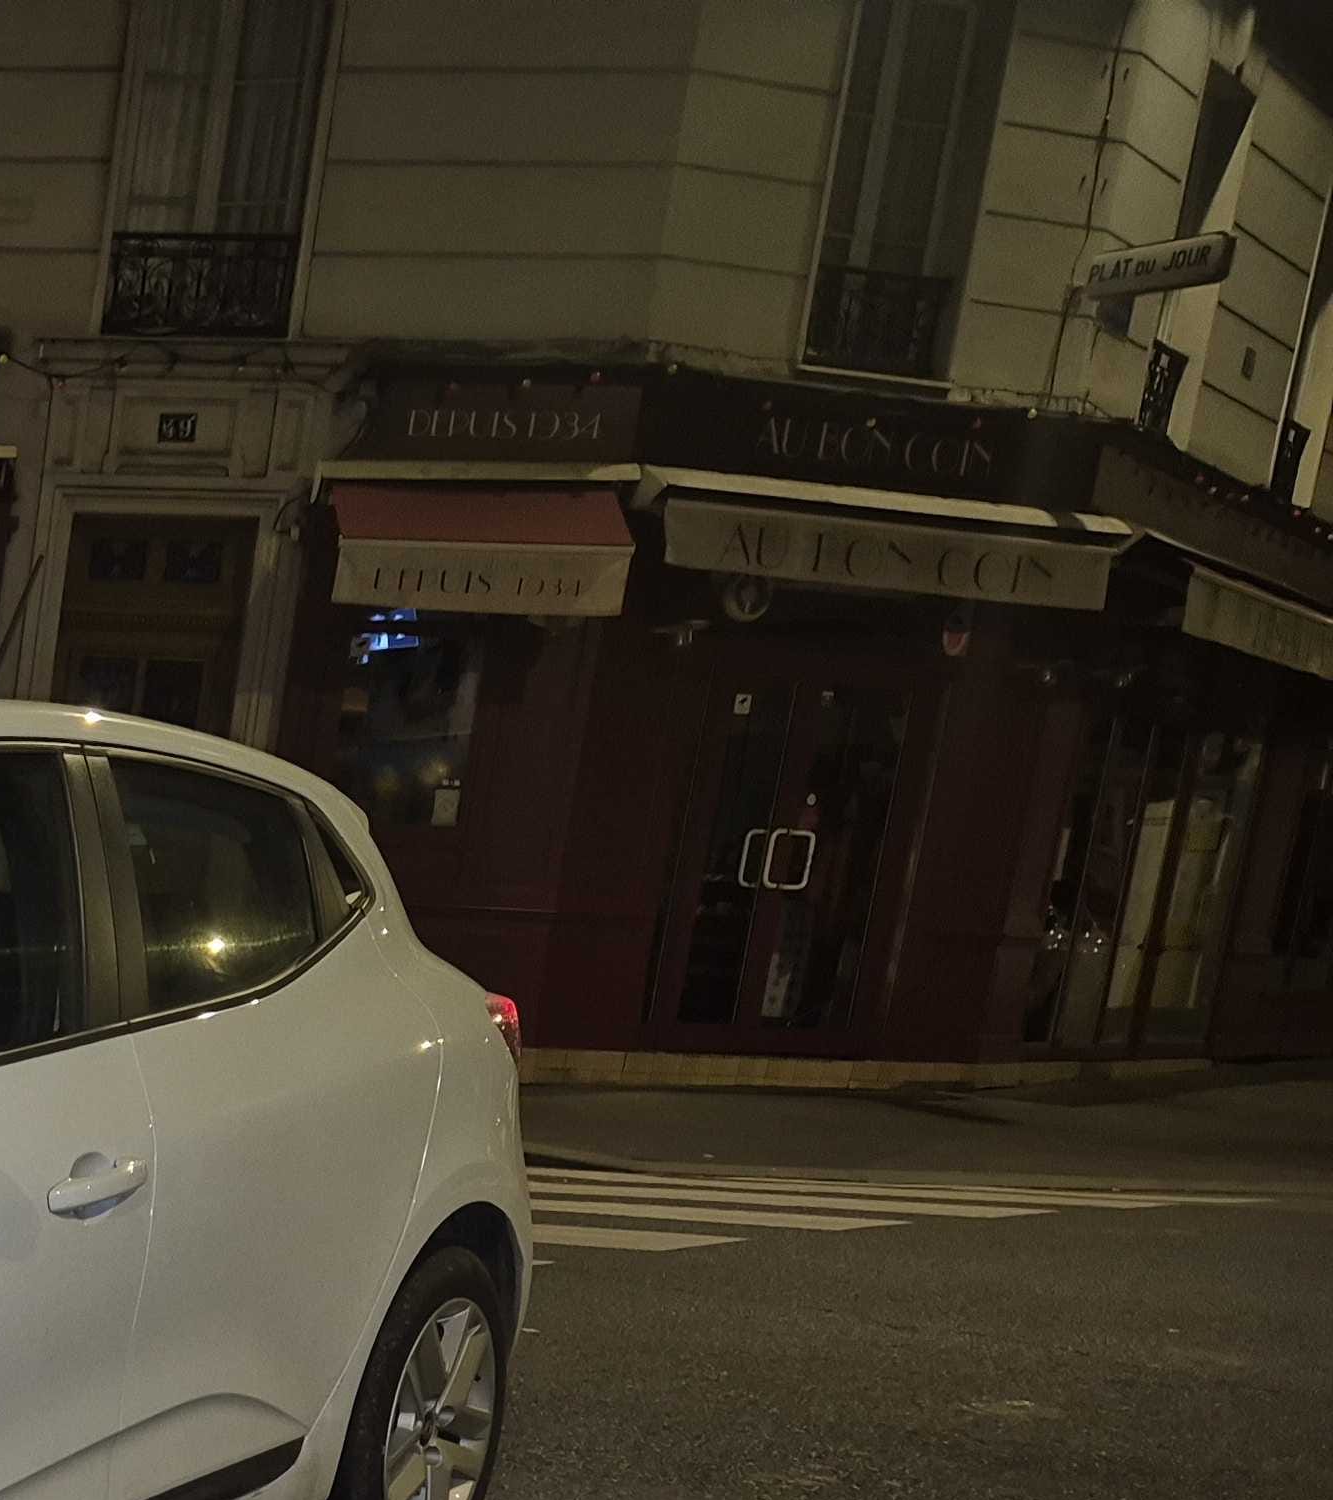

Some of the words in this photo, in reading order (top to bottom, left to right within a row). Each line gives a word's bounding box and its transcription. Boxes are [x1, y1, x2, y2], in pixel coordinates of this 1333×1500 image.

[1088, 258, 1133, 284] PLAT
[1135, 258, 1156, 276] DU
[1163, 245, 1212, 272] JOUR
[406, 407, 518, 440] DEPUIS
[526, 410, 606, 441] 1934
[756, 416, 808, 459] AU
